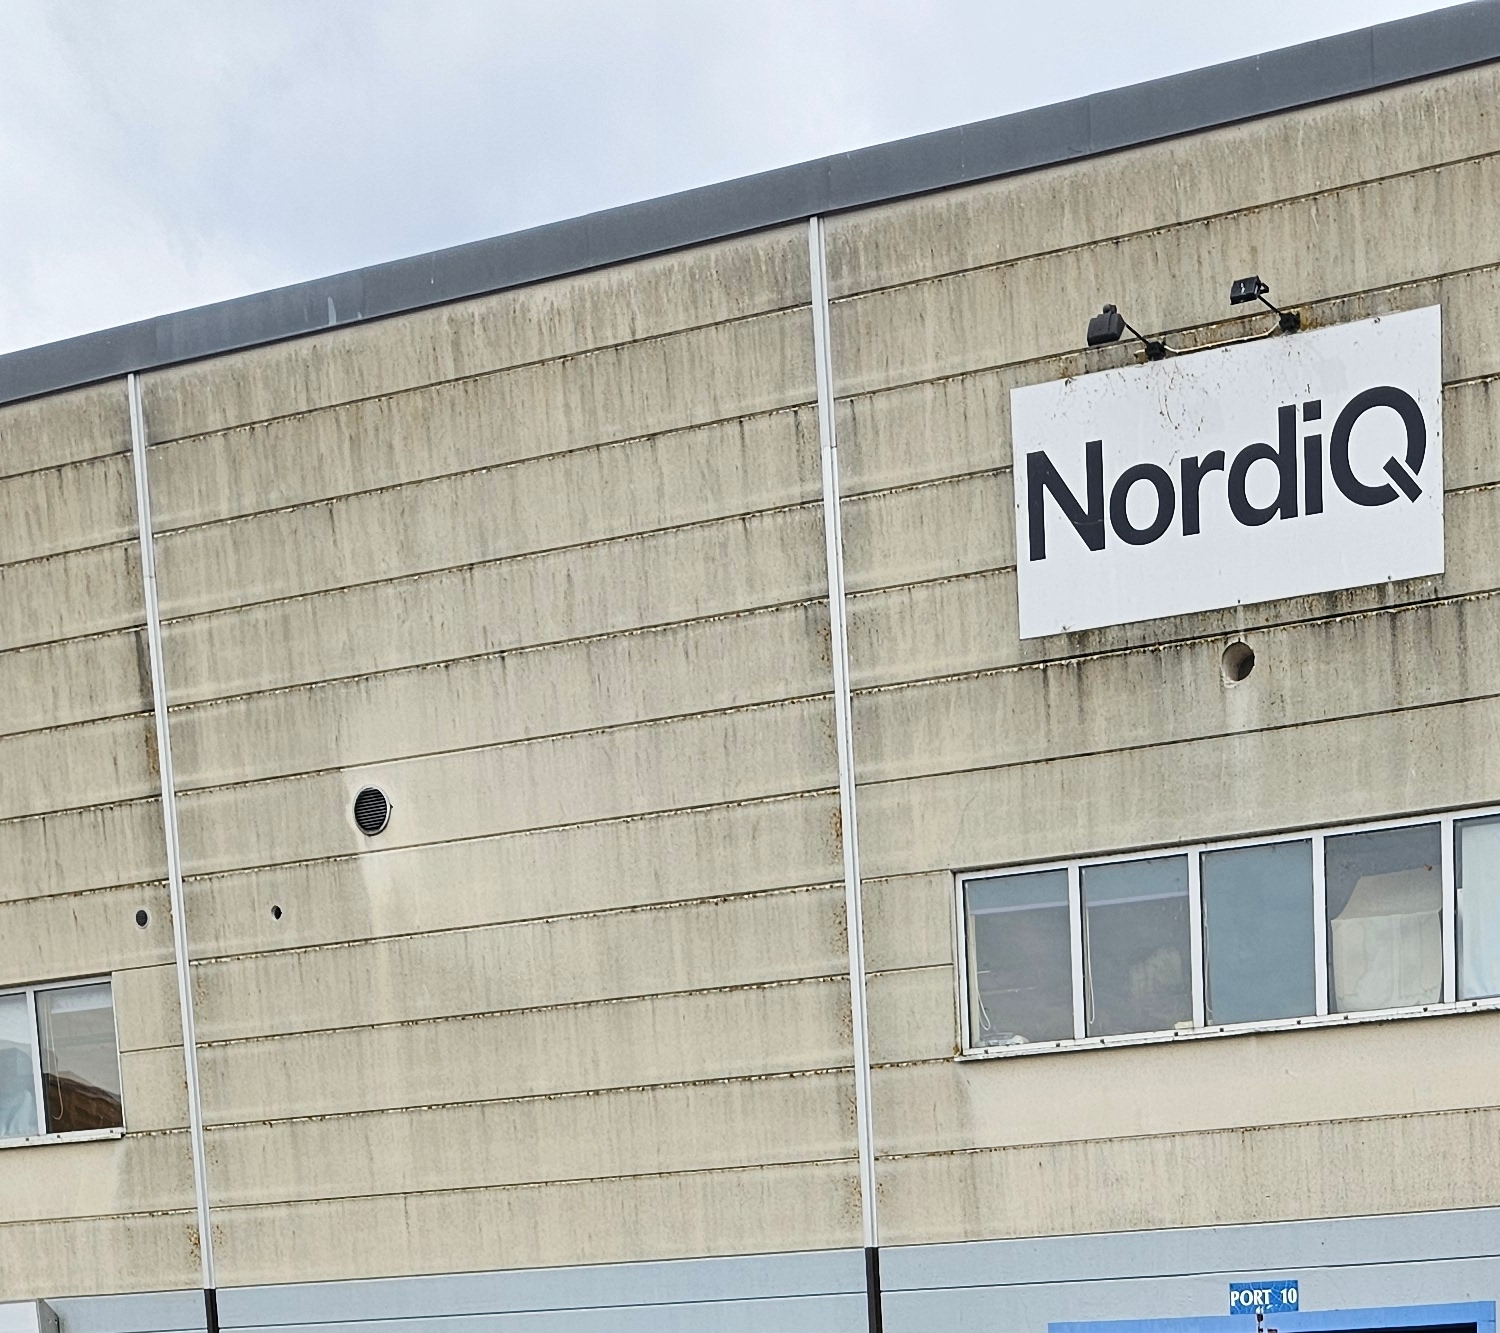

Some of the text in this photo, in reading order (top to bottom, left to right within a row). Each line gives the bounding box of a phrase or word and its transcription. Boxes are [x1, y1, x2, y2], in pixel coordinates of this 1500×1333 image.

[1026, 385, 1427, 562] NordiQ
[1229, 1287, 1298, 1307] PORT 10
